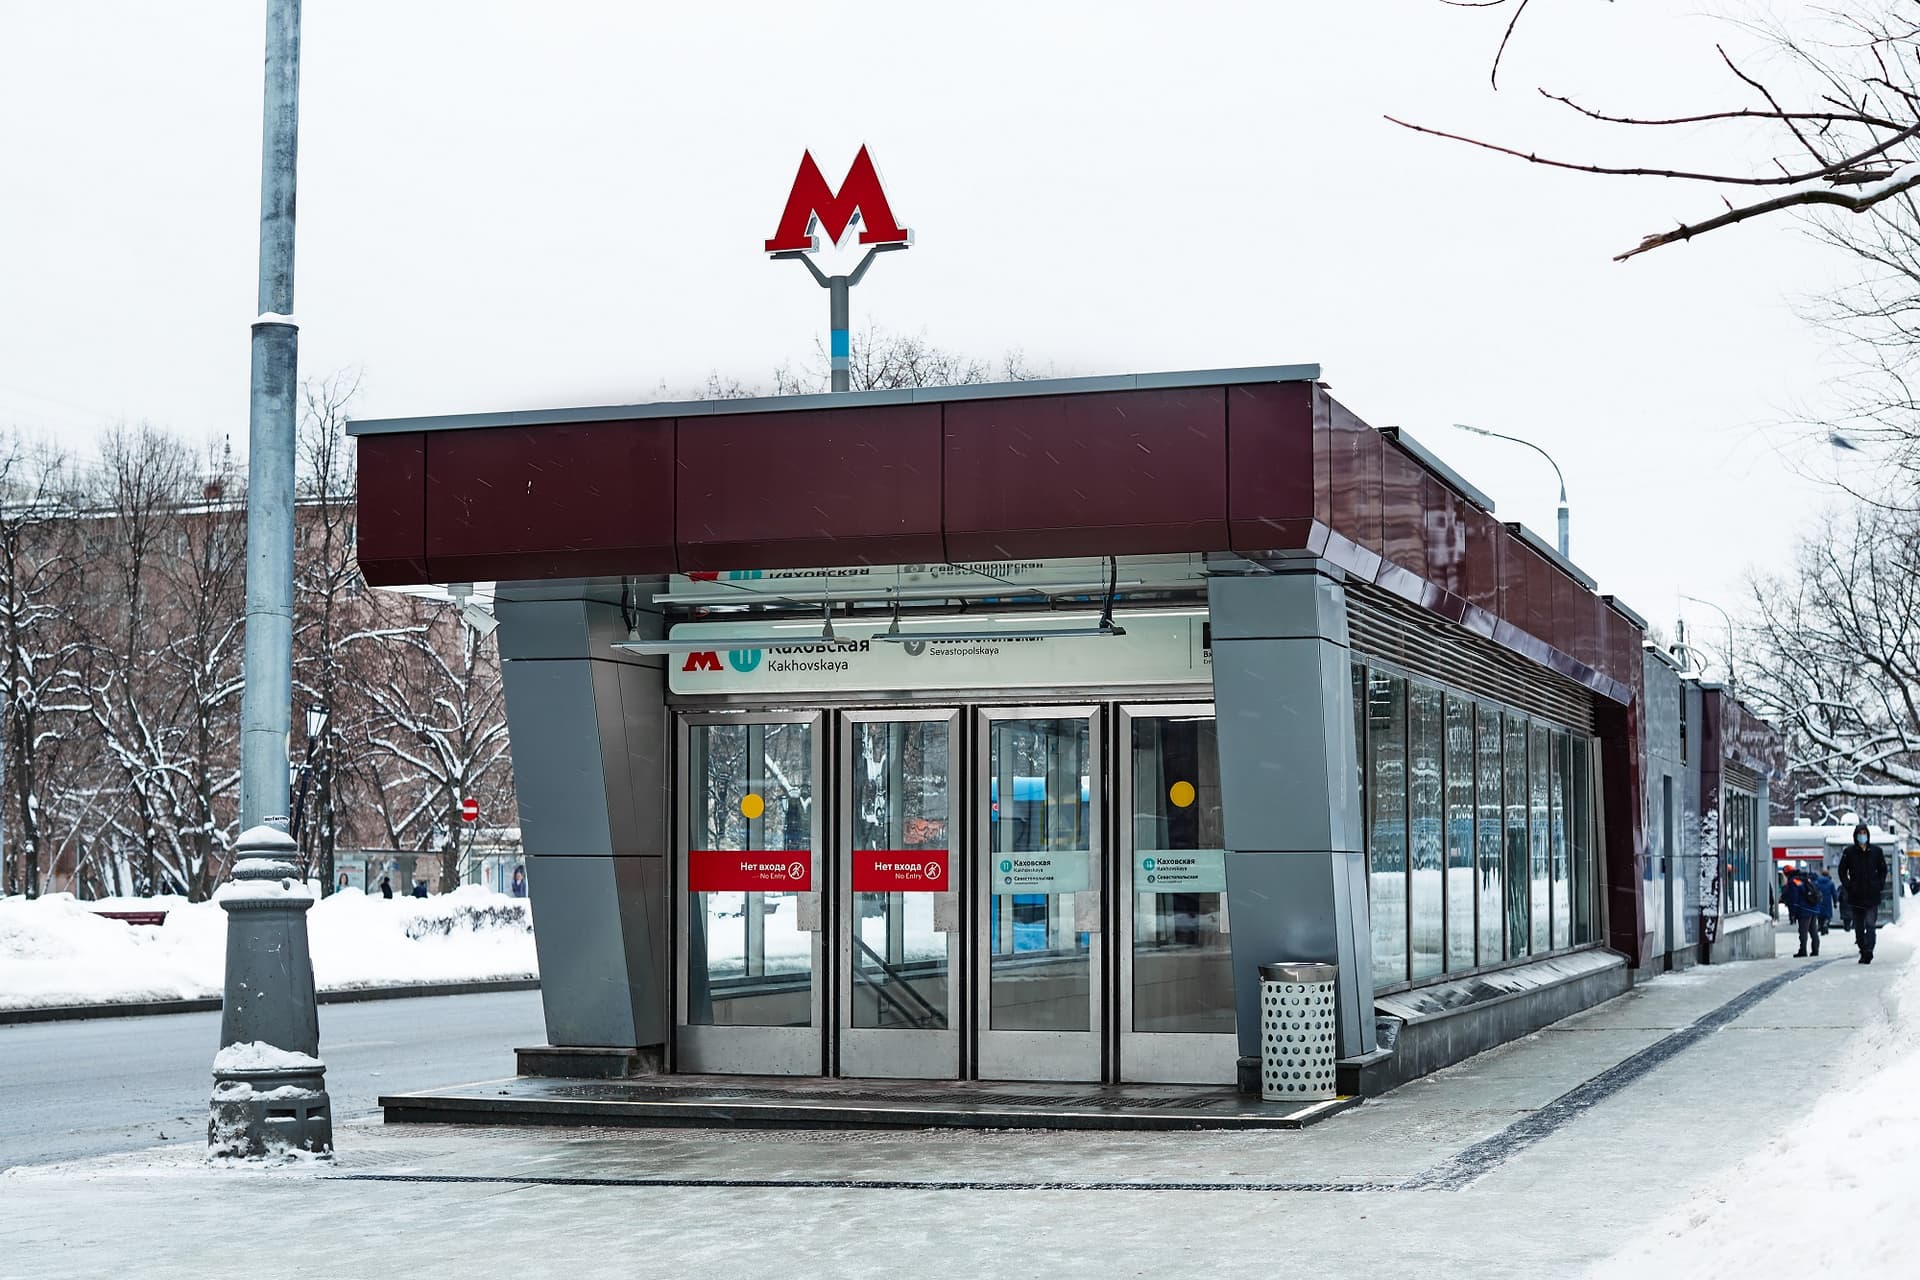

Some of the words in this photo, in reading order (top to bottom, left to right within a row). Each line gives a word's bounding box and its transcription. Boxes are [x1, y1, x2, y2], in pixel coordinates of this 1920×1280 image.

[929, 646, 1000, 657] Sevastopolskaya
[768, 659, 849, 673] Kakhovskaya
[740, 862, 758, 871] Нет
[759, 863, 786, 873] входа
[874, 861, 892, 871] Нет
[894, 863, 922, 873] входа
[770, 873, 786, 881] Entry
[895, 872, 905, 880] No
[906, 872, 922, 881] Entry
